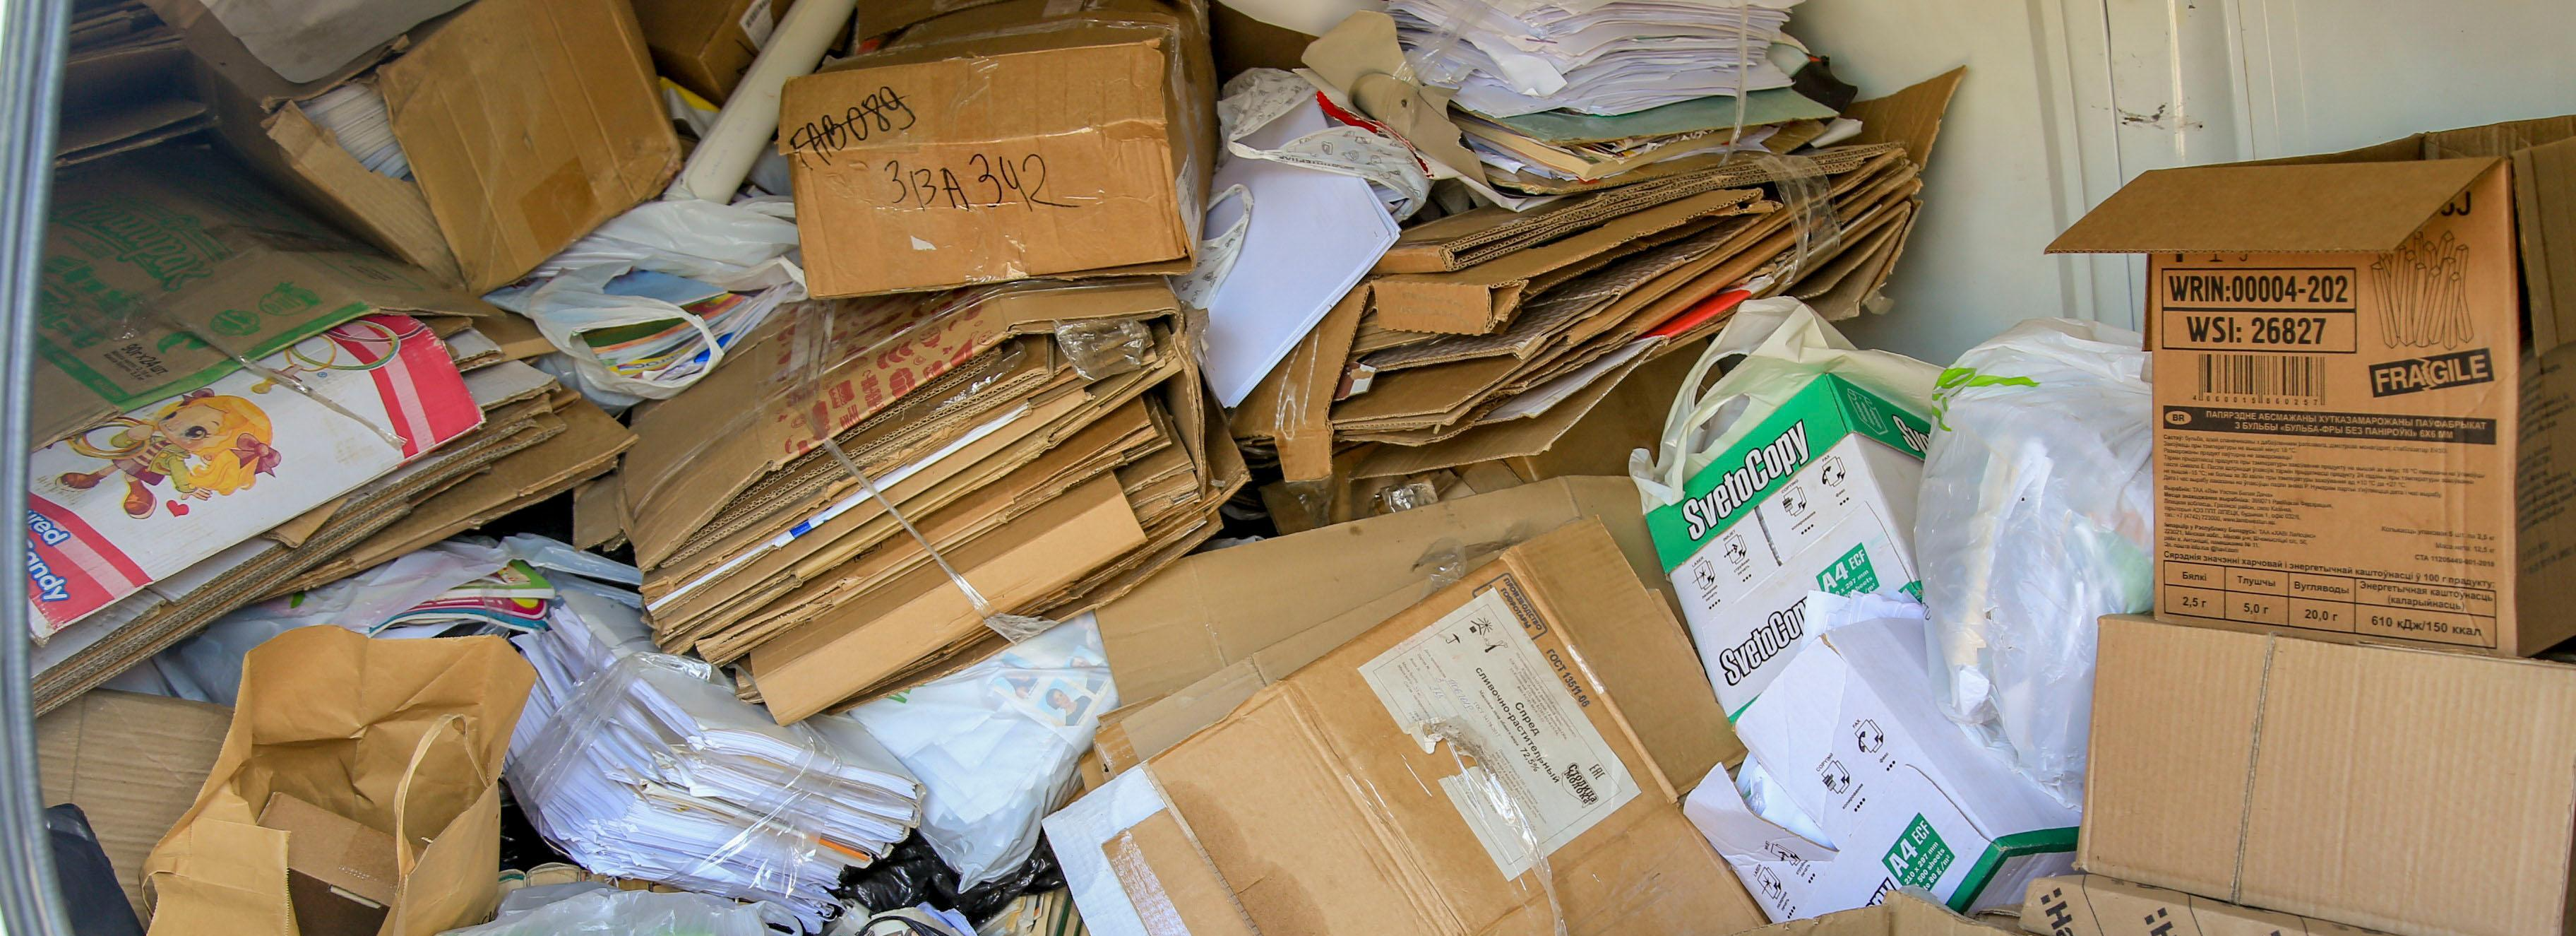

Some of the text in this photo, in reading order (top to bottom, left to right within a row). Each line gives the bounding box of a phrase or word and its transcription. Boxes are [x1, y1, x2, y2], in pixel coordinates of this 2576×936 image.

[2169, 276, 2348, 302] WRIN:00004-202
[2186, 316, 2327, 344] WSI: 26827
[2375, 355, 2489, 393] FRAGILE
[2345, 426, 2363, 434] БЕЗ
[1682, 418, 1810, 542] SvetoCopy
[1822, 549, 1866, 593] A4 ECF
[2164, 551, 2202, 561] Сярэднія
[2203, 556, 2240, 564] значэнні
[2242, 558, 2283, 569] харчовай
[2289, 563, 2353, 574] энергетычнай
[2355, 568, 2414, 580] каштоўнасці
[2424, 573, 2440, 582] 100
[2183, 571, 2207, 581] Бялкі
[1854, 576, 1873, 592] heets
[2237, 575, 2277, 587] Тлушчы
[2294, 581, 2350, 594] Вугляводы
[2360, 581, 2493, 602] Энергетычная каштоўнасць
[1501, 587, 1532, 629] ГОФРОТАРЫ
[1503, 577, 1542, 632] ПРОИЗВОДСТВО
[2183, 597, 2198, 608] 2,5
[2243, 603, 2260, 615] 5,0
[2304, 609, 2329, 622] 20,0
[2387, 594, 2465, 612] (каларыйнасць)
[2371, 615, 2482, 636] 610 кДж/150 ккал
[1546, 648, 1566, 673] ГОСТ
[1475, 667, 1560, 783] сливочно-растительный
[1515, 702, 1541, 737] Спред
[1520, 747, 1542, 773] 72,5%
[1568, 764, 1598, 802] Столица
[1888, 820, 1931, 878] A4 ECF
[1904, 871, 1916, 885] 210
[1917, 853, 1929, 868] 297
[1928, 841, 1939, 855] mm
[1916, 848, 1945, 883] 500 sheets
[1928, 872, 1937, 883] 80
